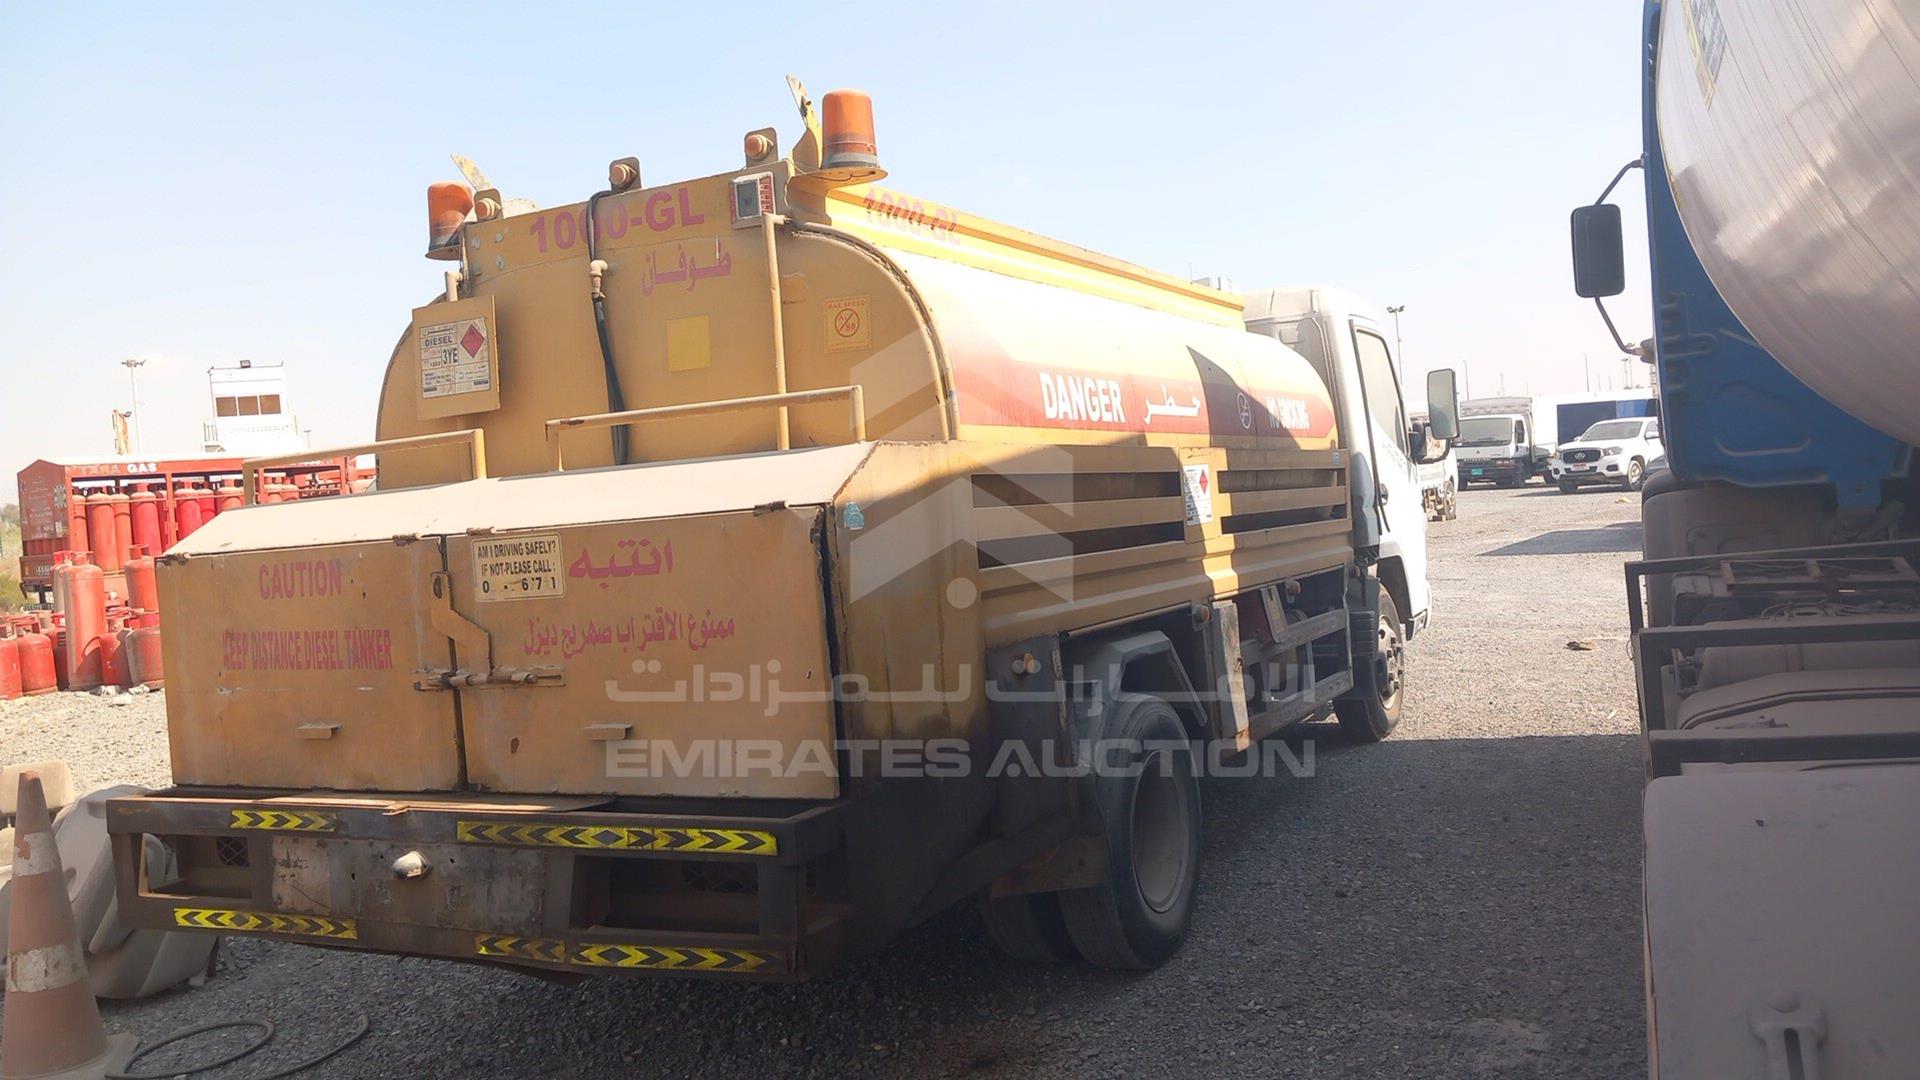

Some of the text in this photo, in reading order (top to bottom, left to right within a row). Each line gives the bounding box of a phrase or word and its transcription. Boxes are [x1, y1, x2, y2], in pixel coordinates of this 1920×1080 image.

[530, 188, 704, 253] 1000-GL
[424, 336, 453, 347] DIESEL
[442, 347, 458, 365] 3YE
[1039, 371, 1126, 423] DANGER
[1143, 384, 1200, 425] خطر
[126, 462, 158, 473] GAS
[477, 545, 488, 559] AM
[494, 542, 523, 558] DRIVING
[524, 540, 556, 556] SAFELY?
[481, 563, 488, 577] IF
[568, 538, 674, 589] انتبه
[258, 558, 343, 600] CAUTION
[524, 616, 558, 656] ديزل
[688, 608, 735, 650] ممنوع
[222, 629, 393, 671] KEEP DISTANCE DIESEL TANKER
